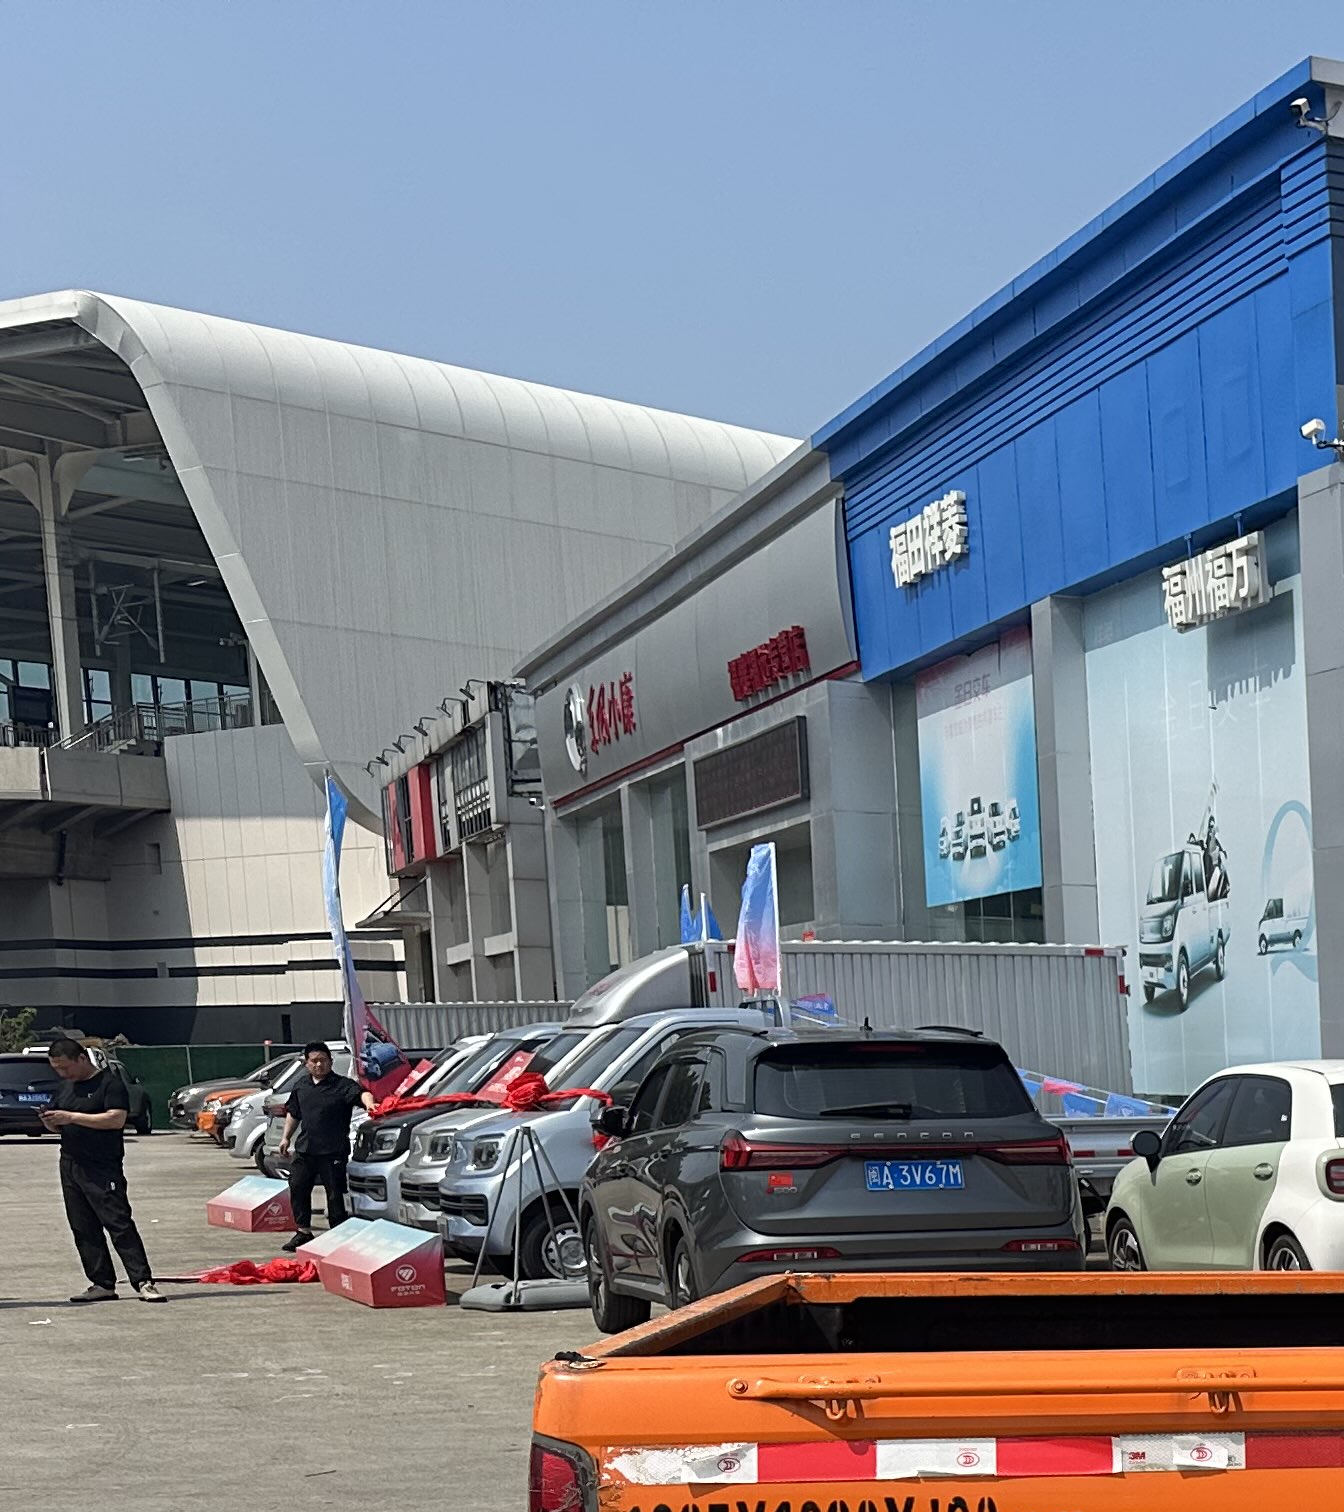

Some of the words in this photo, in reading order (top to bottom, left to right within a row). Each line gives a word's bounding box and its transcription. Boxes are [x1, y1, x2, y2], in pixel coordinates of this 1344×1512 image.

[889, 490, 967, 588] 福田祥菱
[1162, 531, 1262, 630] 福州福万
